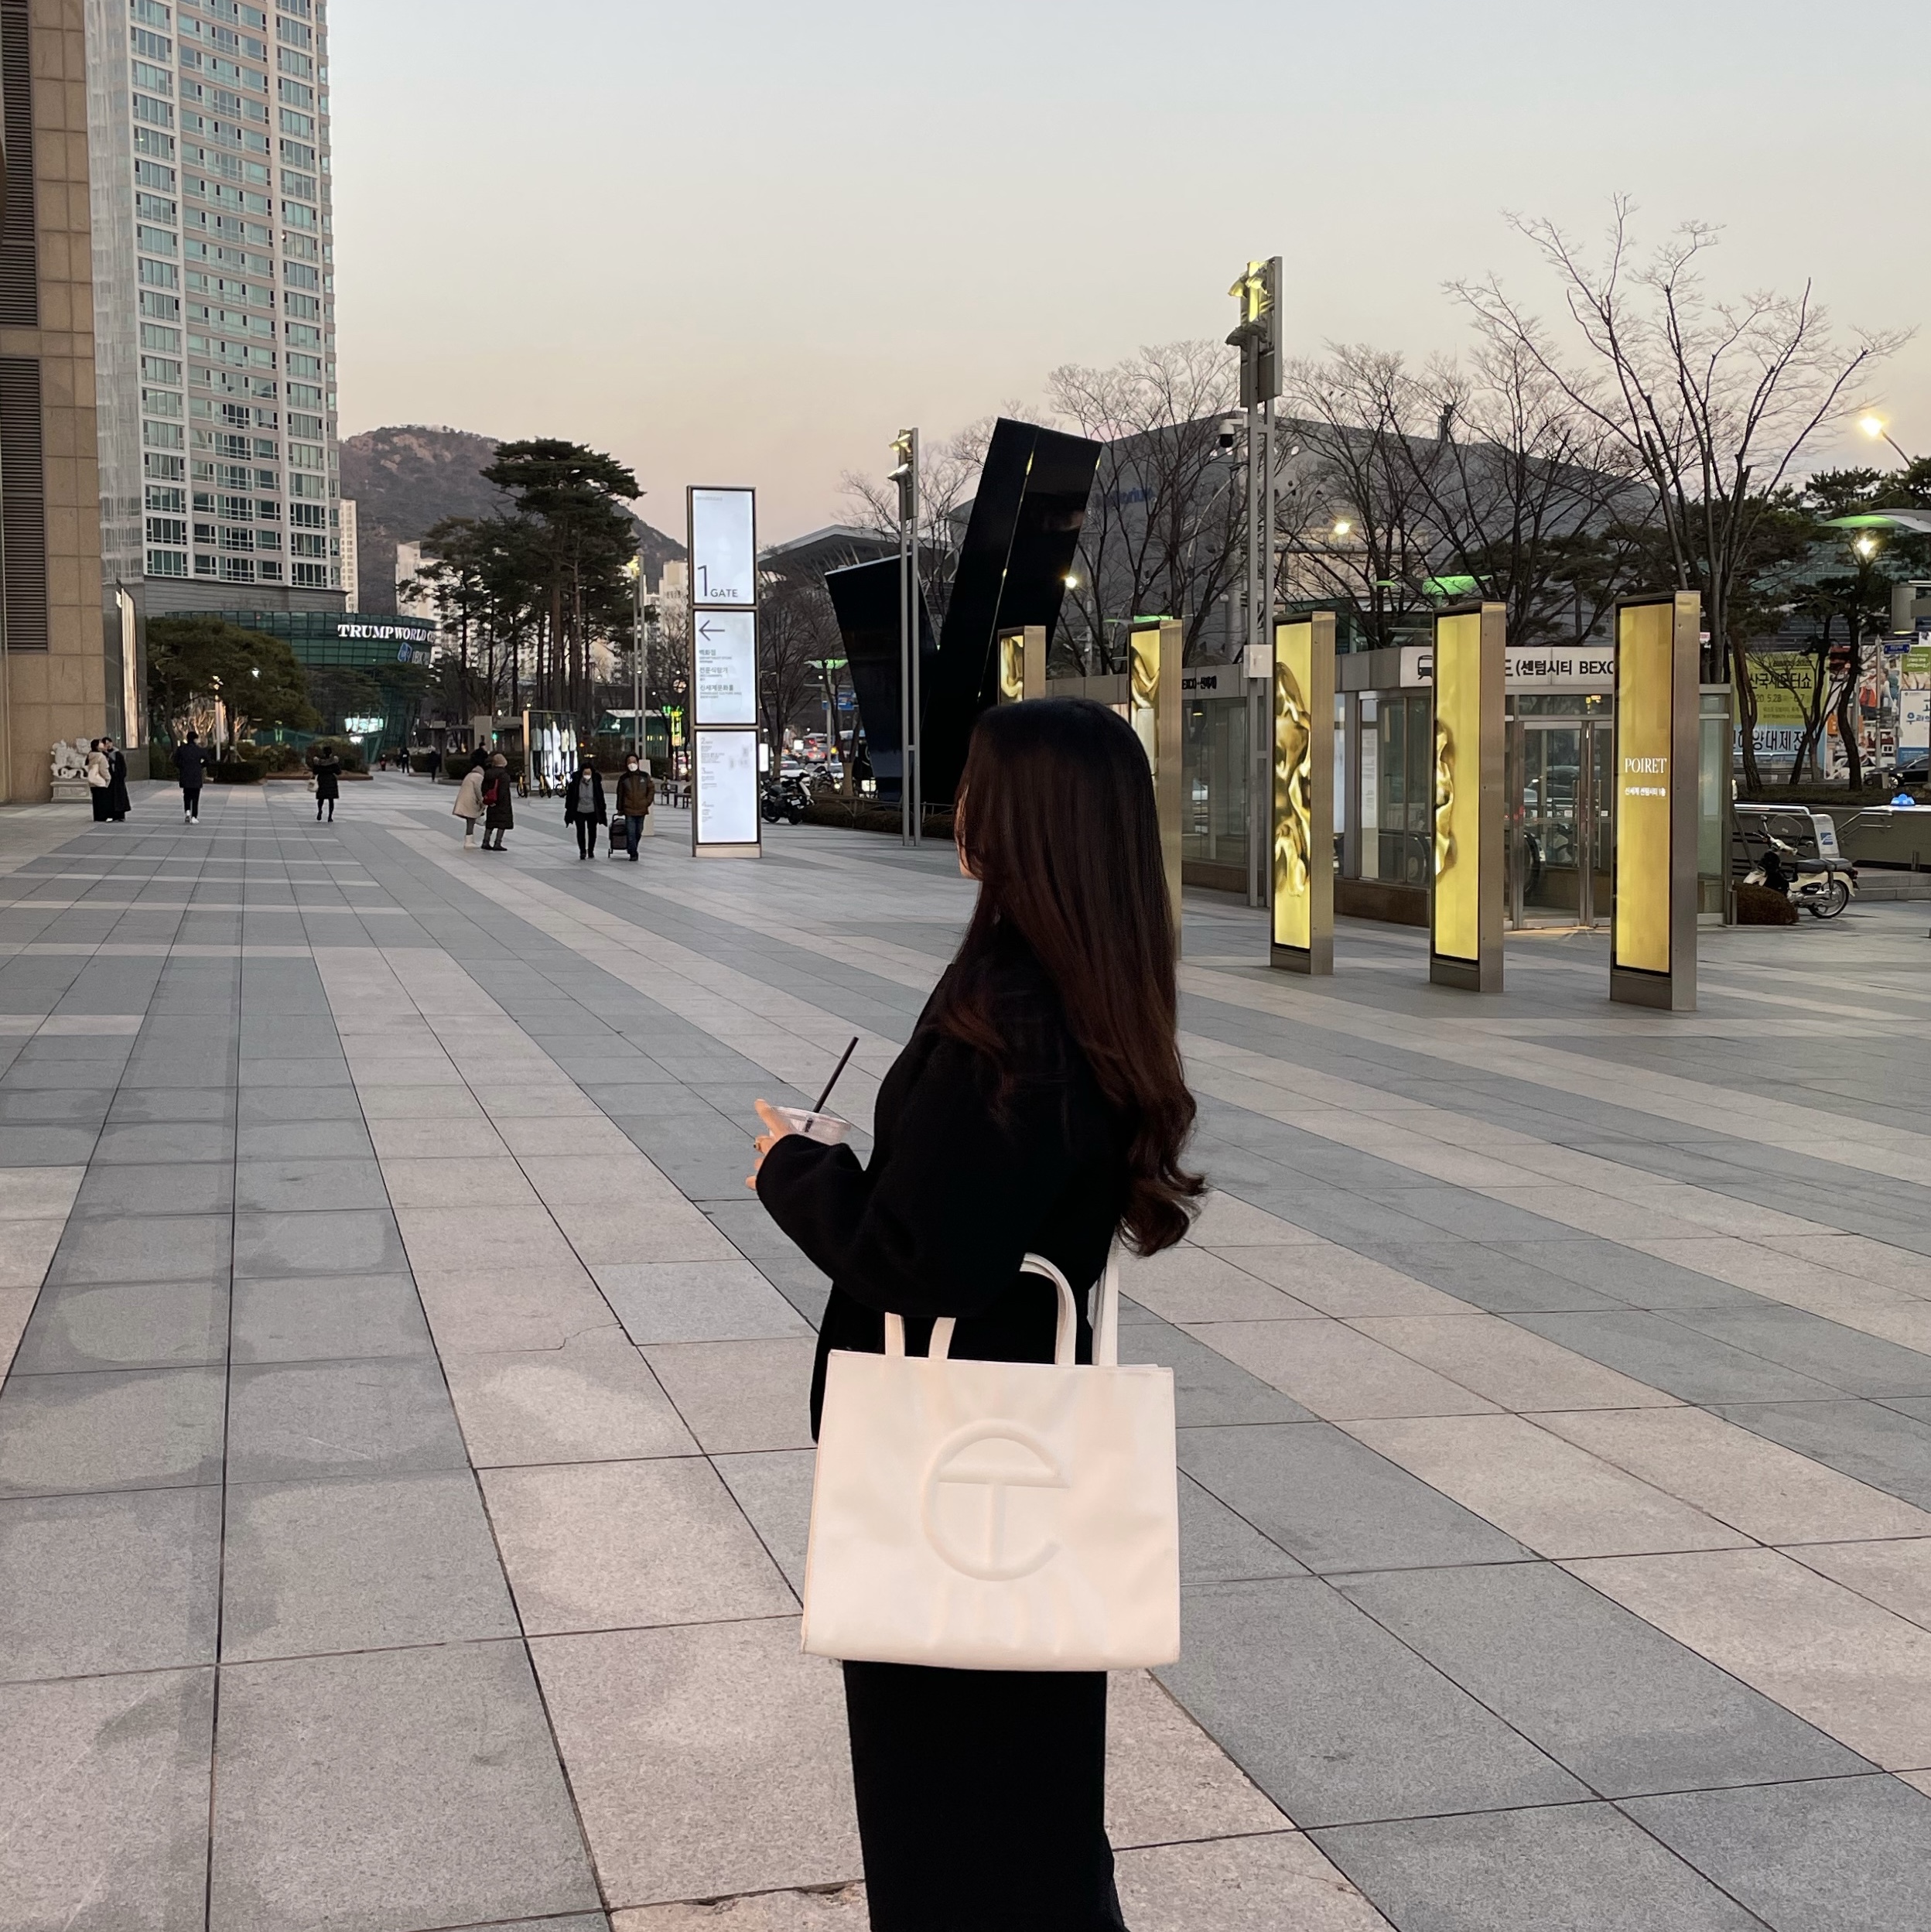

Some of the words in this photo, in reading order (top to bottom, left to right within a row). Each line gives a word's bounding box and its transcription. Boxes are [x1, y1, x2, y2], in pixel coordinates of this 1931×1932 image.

[696, 564, 708, 597] 1
[709, 588, 738, 598] GATE
[337, 624, 394, 639] TRUMP
[395, 627, 427, 641] WORLD
[1625, 757, 1667, 773] POIRET
